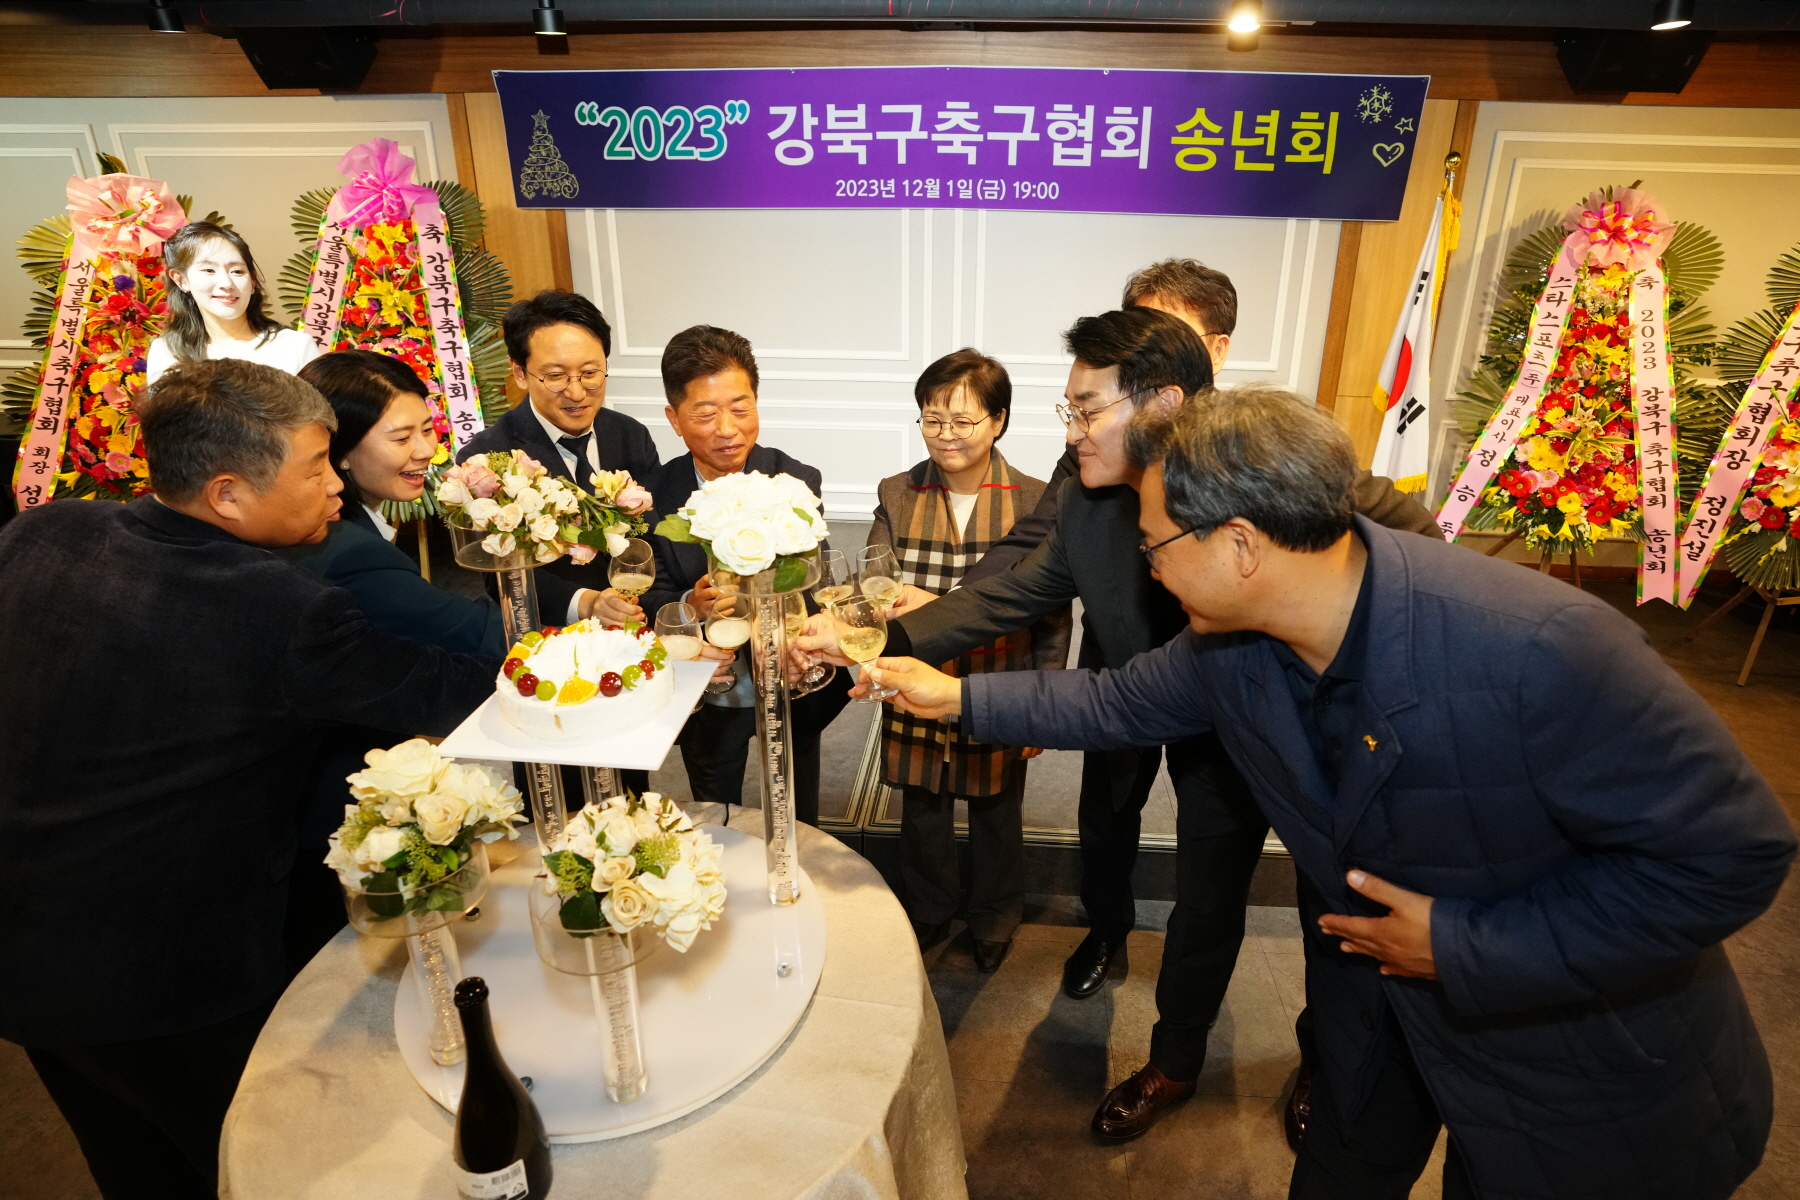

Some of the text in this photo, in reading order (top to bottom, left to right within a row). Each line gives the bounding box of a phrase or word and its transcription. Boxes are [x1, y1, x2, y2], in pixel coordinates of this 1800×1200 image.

[767, 101, 1153, 170] 강북구축구협회
[1170, 107, 1340, 174] 송년회
[835, 178, 896, 198] 2023년
[902, 178, 941, 199] 12월
[1012, 181, 1060, 200] 19:00
[421, 223, 445, 244] 축
[1635, 276, 1660, 290] 축
[1641, 309, 1657, 370] 2023
[1492, 394, 1530, 443] 대표이사
[28, 446, 51, 475] 회장
[1645, 528, 1672, 574] 송년회
